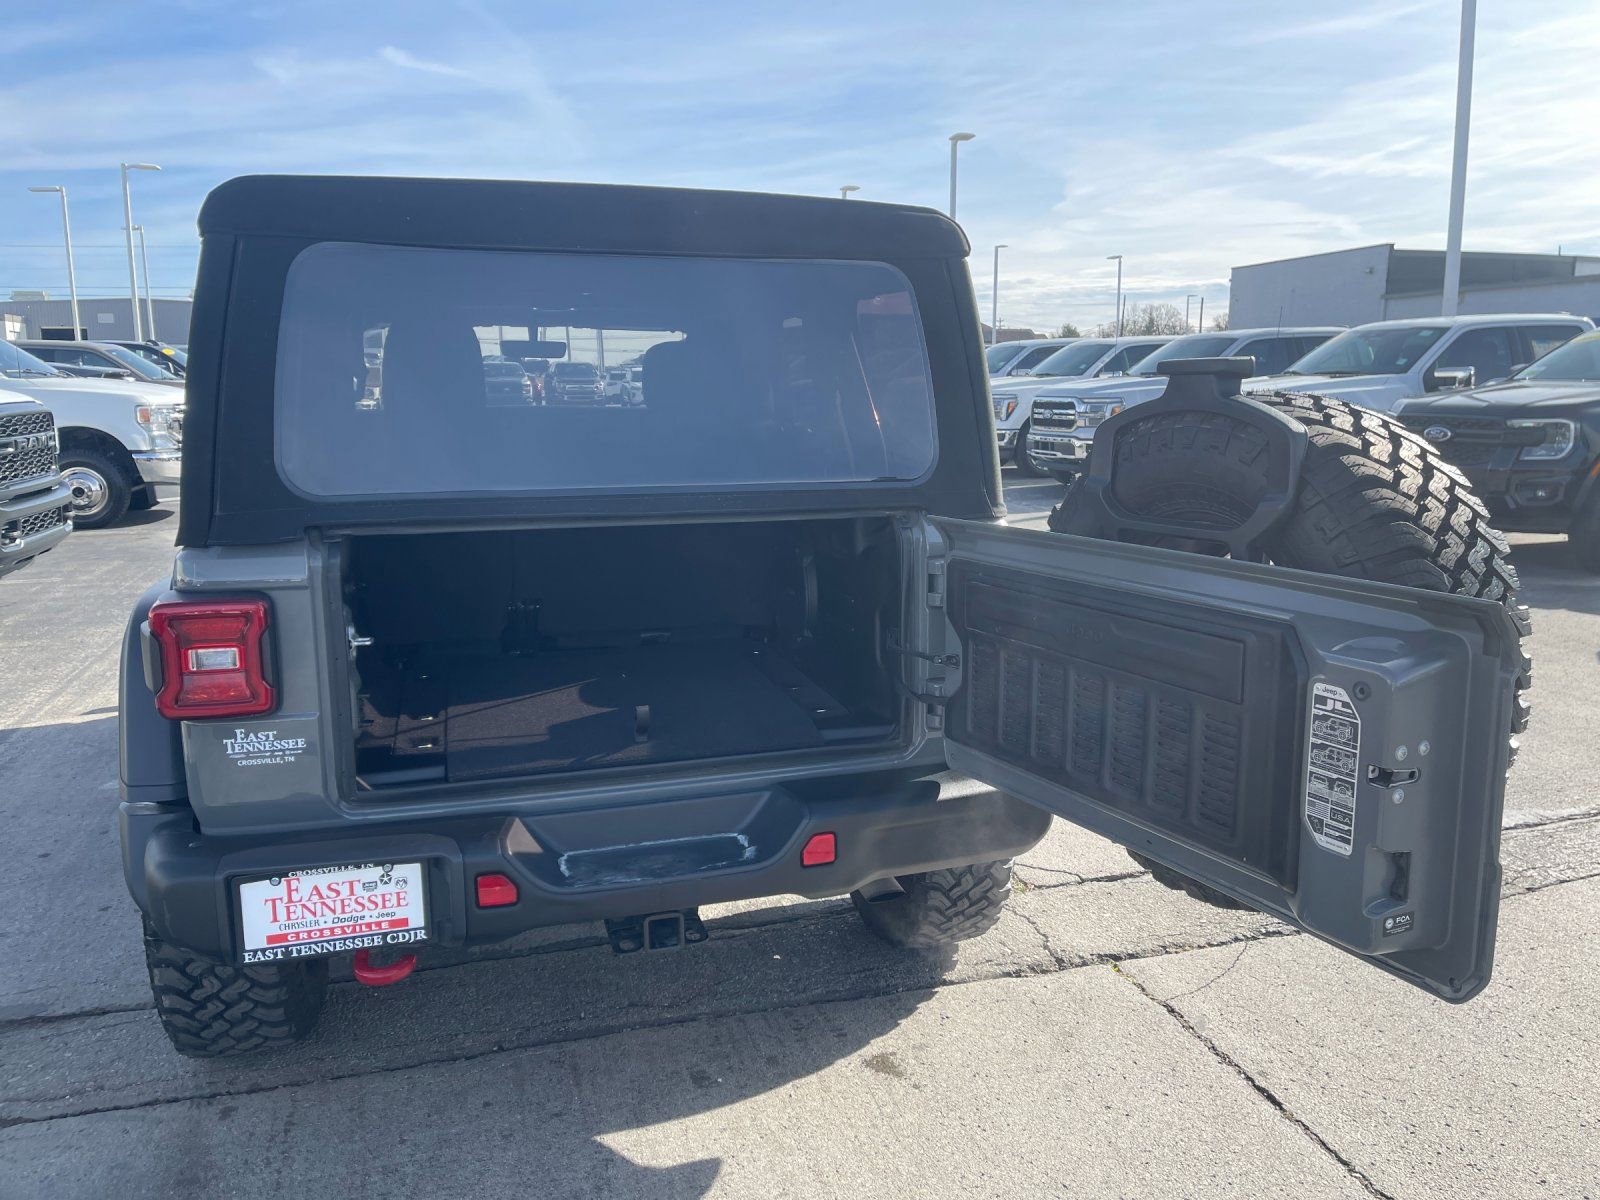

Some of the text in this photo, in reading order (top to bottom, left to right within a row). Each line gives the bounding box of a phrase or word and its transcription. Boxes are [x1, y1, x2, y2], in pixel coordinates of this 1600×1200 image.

[1321, 686, 1338, 697] Jeep
[1315, 698, 1353, 714] JL
[234, 729, 277, 743] EAST
[223, 738, 306, 754] TENNESSEE
[283, 877, 361, 904] EAST
[264, 891, 409, 924] TENNESSEE
[279, 911, 396, 931] CHRYSLER Dodge Jeep
[1396, 915, 1410, 923] FCA
[287, 922, 390, 941] CROSSVILLE
[243, 930, 427, 963] EAST TENNESSEE CDJR
